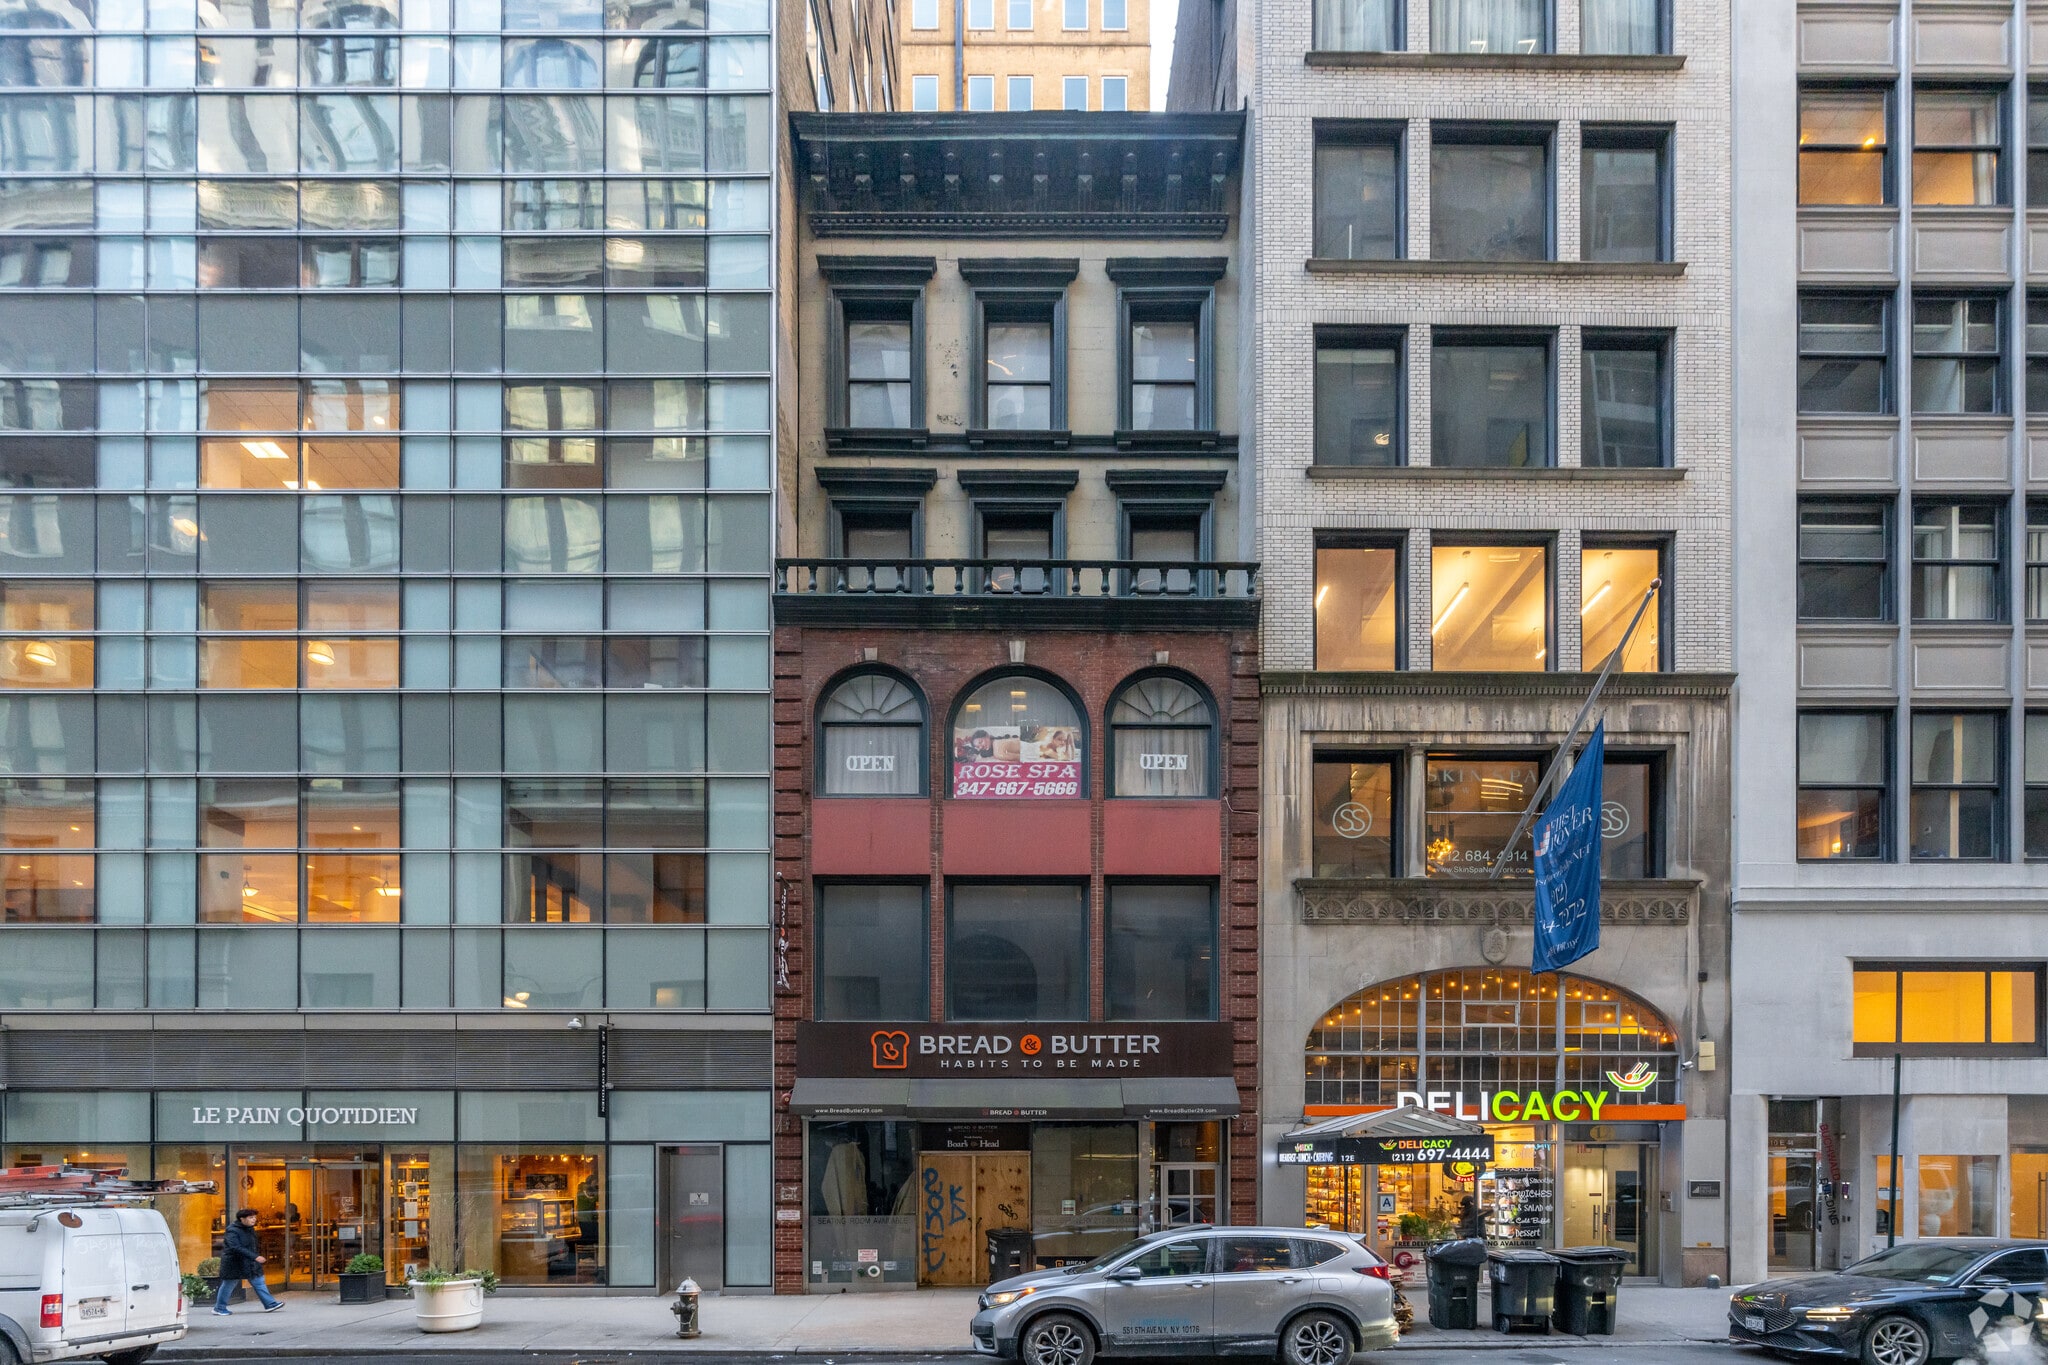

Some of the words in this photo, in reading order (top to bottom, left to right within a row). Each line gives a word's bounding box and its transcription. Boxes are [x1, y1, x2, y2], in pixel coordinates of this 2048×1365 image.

[846, 755, 894, 771] OPEN
[1140, 754, 1188, 770] OPEN
[959, 764, 1021, 779] ROSE
[1026, 764, 1077, 779] SPA
[957, 781, 1078, 796] 347-667-5666
[1440, 850, 1529, 862] 12.684.4914
[1437, 865, 1531, 875] www.SkinSpaNeork.com
[920, 1035, 1012, 1054] BREAD
[1051, 1035, 1160, 1054] BUTTER
[941, 1060, 1009, 1068] HABITS
[1021, 1060, 1042, 1068] TO
[1057, 1060, 1077, 1068] BE
[1091, 1060, 1140, 1068] MADE
[1396, 1091, 1608, 1122] DELICACY
[193, 1107, 220, 1124] LE
[226, 1107, 281, 1124] PAIN
[286, 1107, 417, 1127] QUOTIDIEN
[980, 1140, 999, 1148] Head
[1399, 1140, 1452, 1149] DELICACY
[1392, 1153, 1415, 1162] (212)
[1417, 1147, 1490, 1161] 697-4444
[1382, 1198, 1392, 1208] A
